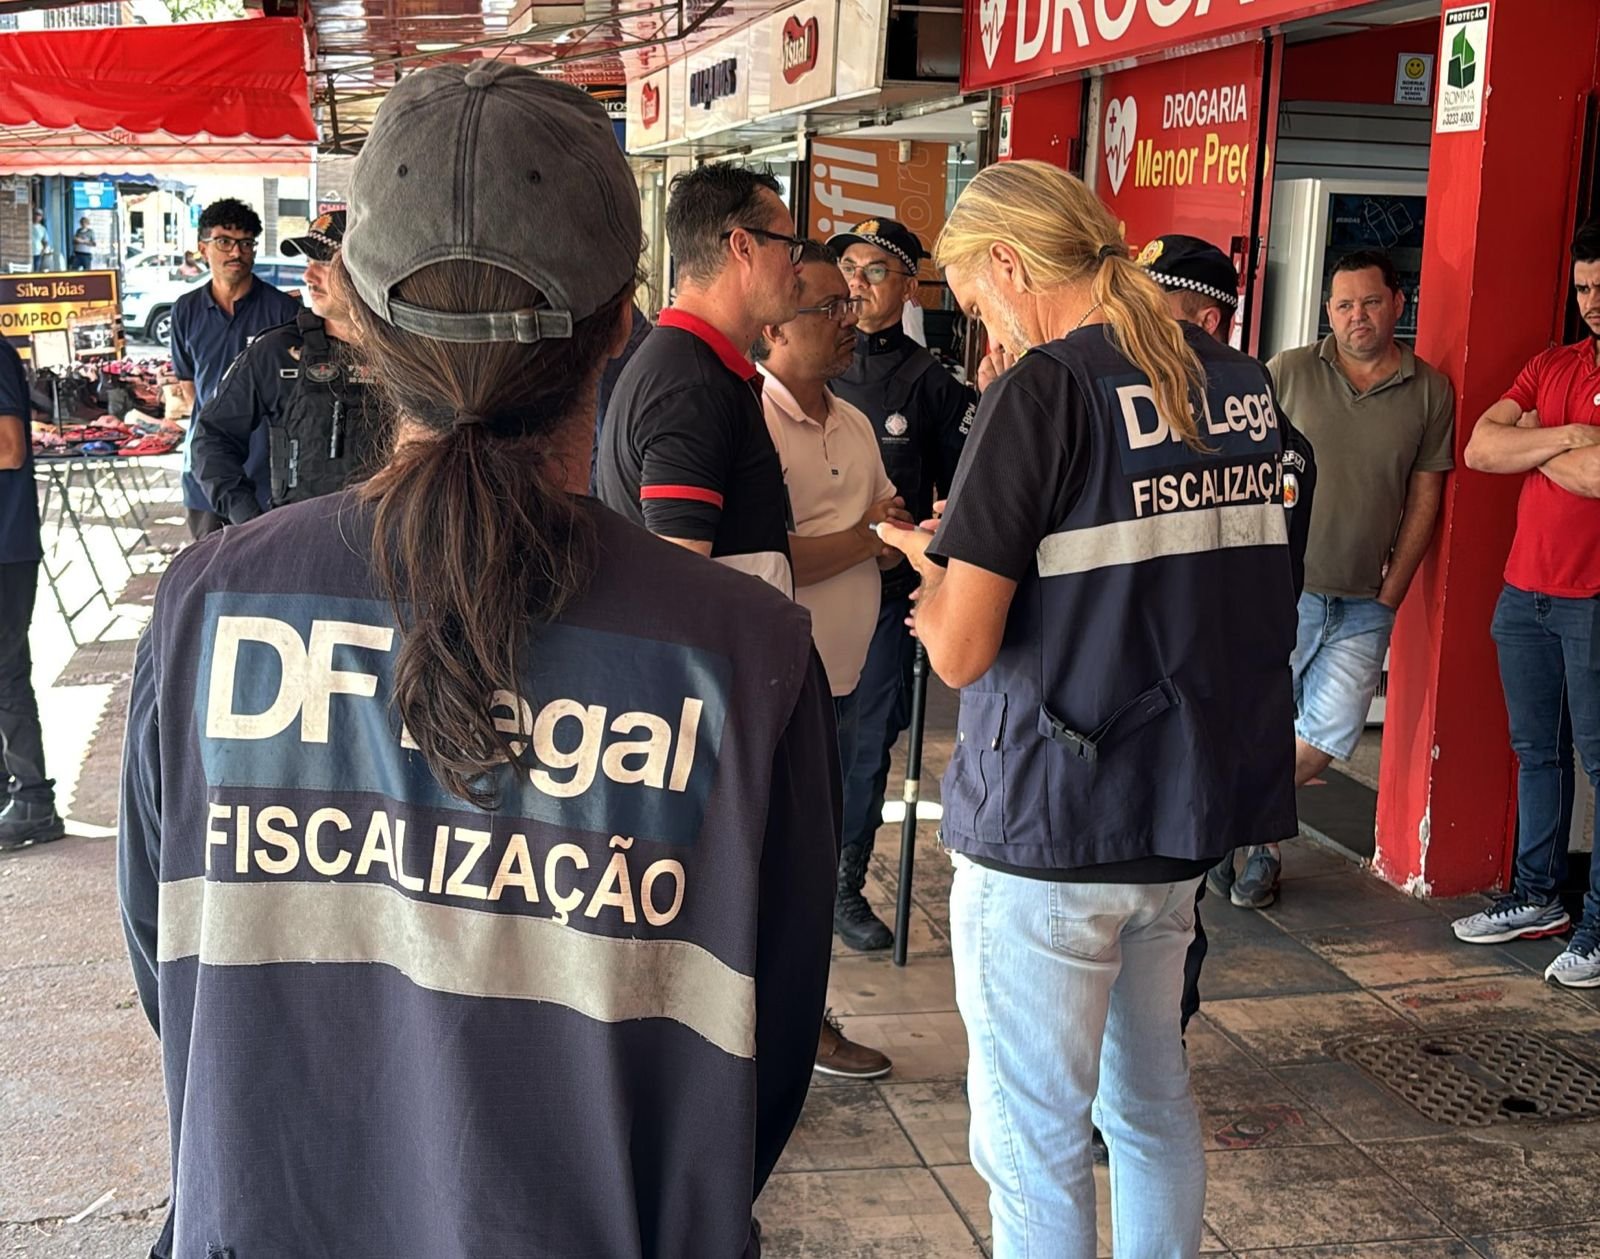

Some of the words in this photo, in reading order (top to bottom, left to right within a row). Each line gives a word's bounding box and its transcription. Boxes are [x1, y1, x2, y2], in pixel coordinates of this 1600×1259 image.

[1449, 8, 1485, 23] PROTEÇÃO
[1162, 84, 1247, 130] DROGARIA
[1135, 140, 1199, 188] Menor
[16, 282, 49, 298] Silva
[51, 281, 86, 299] Jóias
[0, 312, 61, 327] OMPRO
[1200, 383, 1278, 442] Legal
[205, 616, 394, 743] DF
[400, 689, 704, 798] egal
[205, 802, 686, 927] FISCALIZAÇÃO
